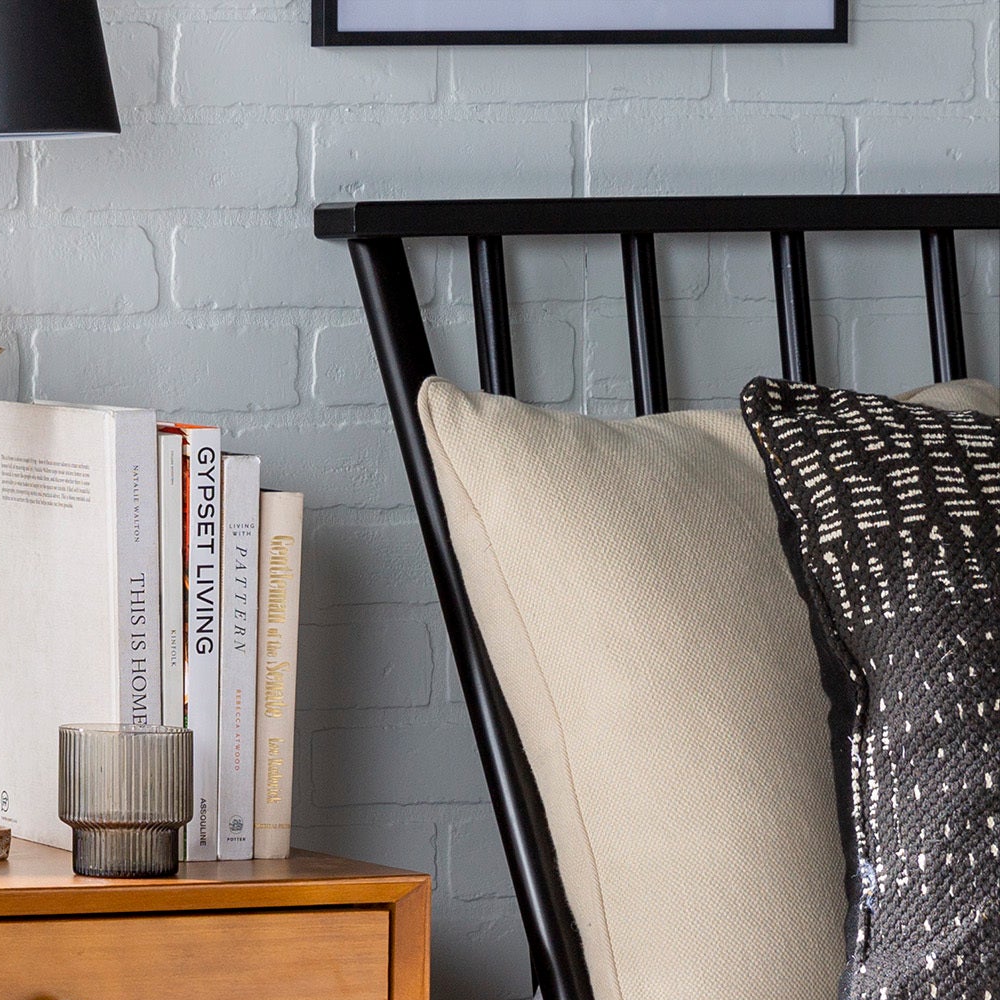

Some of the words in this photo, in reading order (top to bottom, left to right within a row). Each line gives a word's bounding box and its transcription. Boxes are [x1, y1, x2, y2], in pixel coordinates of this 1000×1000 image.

[132, 465, 140, 507] NATALIE
[196, 446, 216, 555] GYPSET
[133, 508, 141, 543] WALTON
[130, 573, 146, 625] THIS
[234, 545, 248, 653] PATTERN
[267, 534, 295, 623] Gentleman
[195, 564, 215, 655] LIVING
[266, 627, 282, 638] of
[131, 633, 147, 651] IS
[266, 641, 281, 657] the
[131, 659, 148, 726] HOME
[263, 661, 291, 718] Senate
[234, 733, 242, 772] ATWOOD
[199, 797, 207, 847] ASSOULINE
